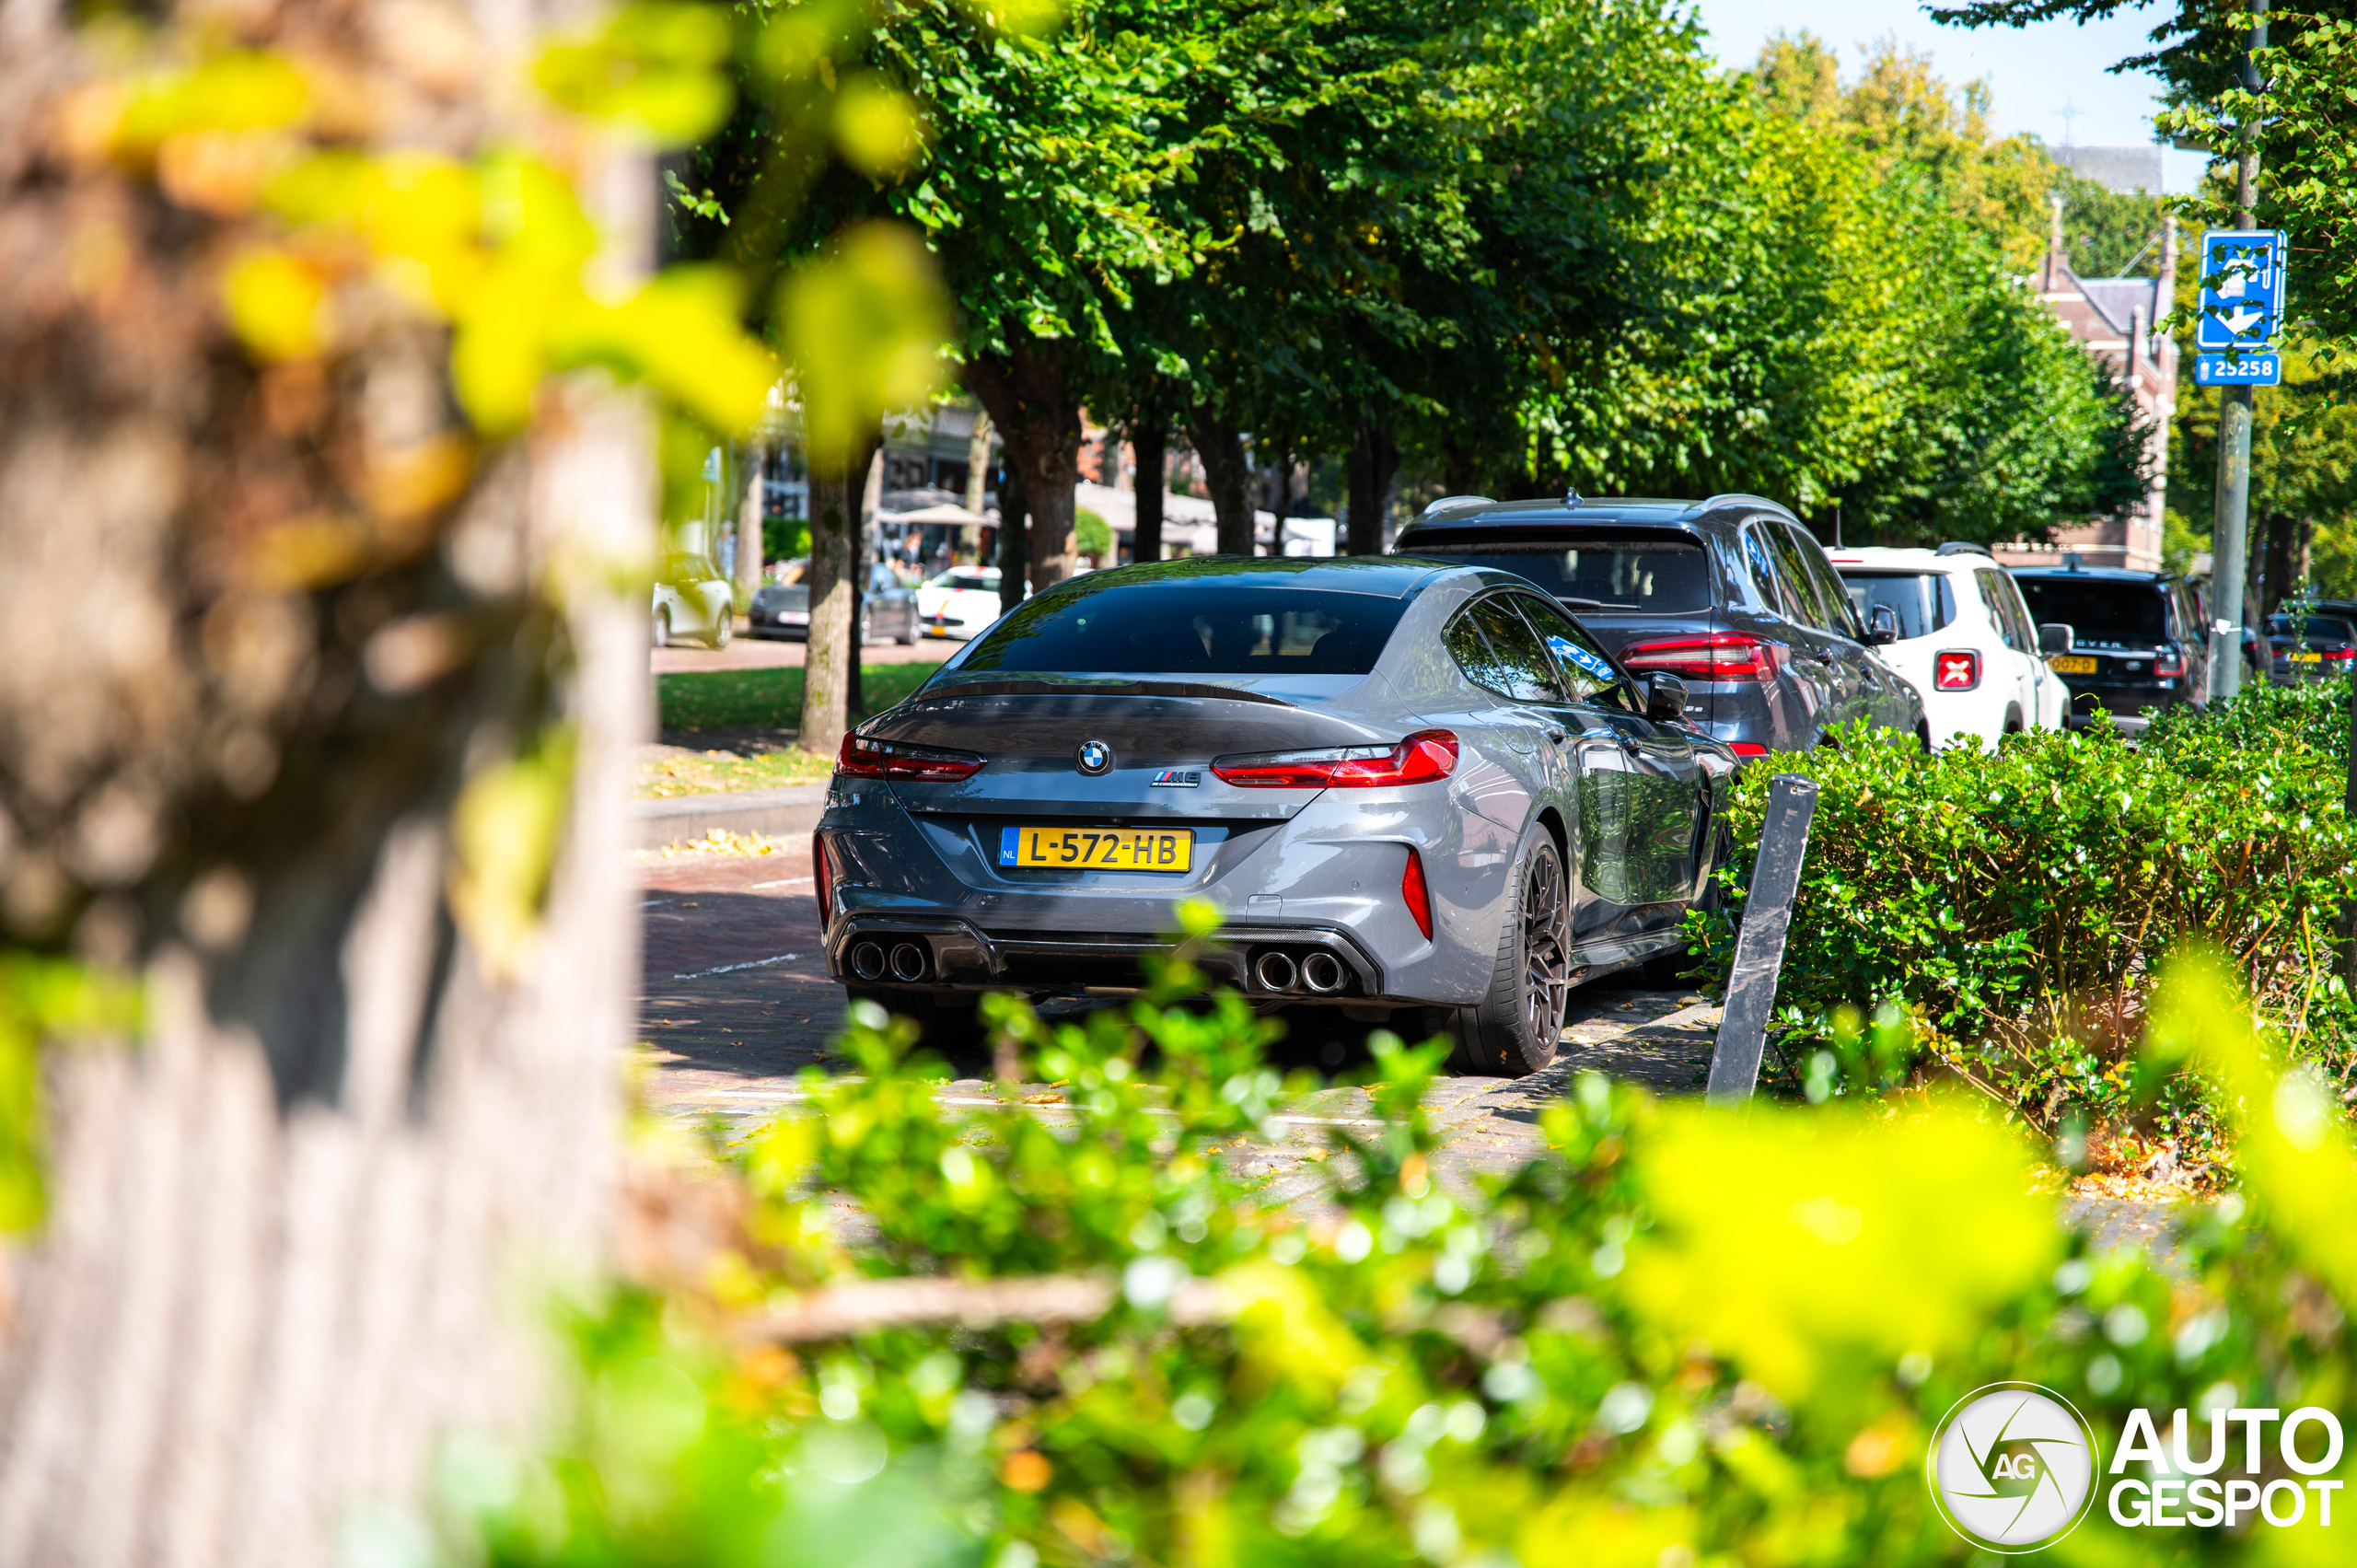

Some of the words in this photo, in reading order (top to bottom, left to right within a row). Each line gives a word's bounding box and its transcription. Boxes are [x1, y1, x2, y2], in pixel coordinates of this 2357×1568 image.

[2214, 361, 2273, 377] 25258
[2076, 639, 2121, 648] OVER
[2049, 658, 2090, 669] 007-D
[1030, 832, 1177, 864] L-572-HB
[1003, 850, 1016, 859] NL
